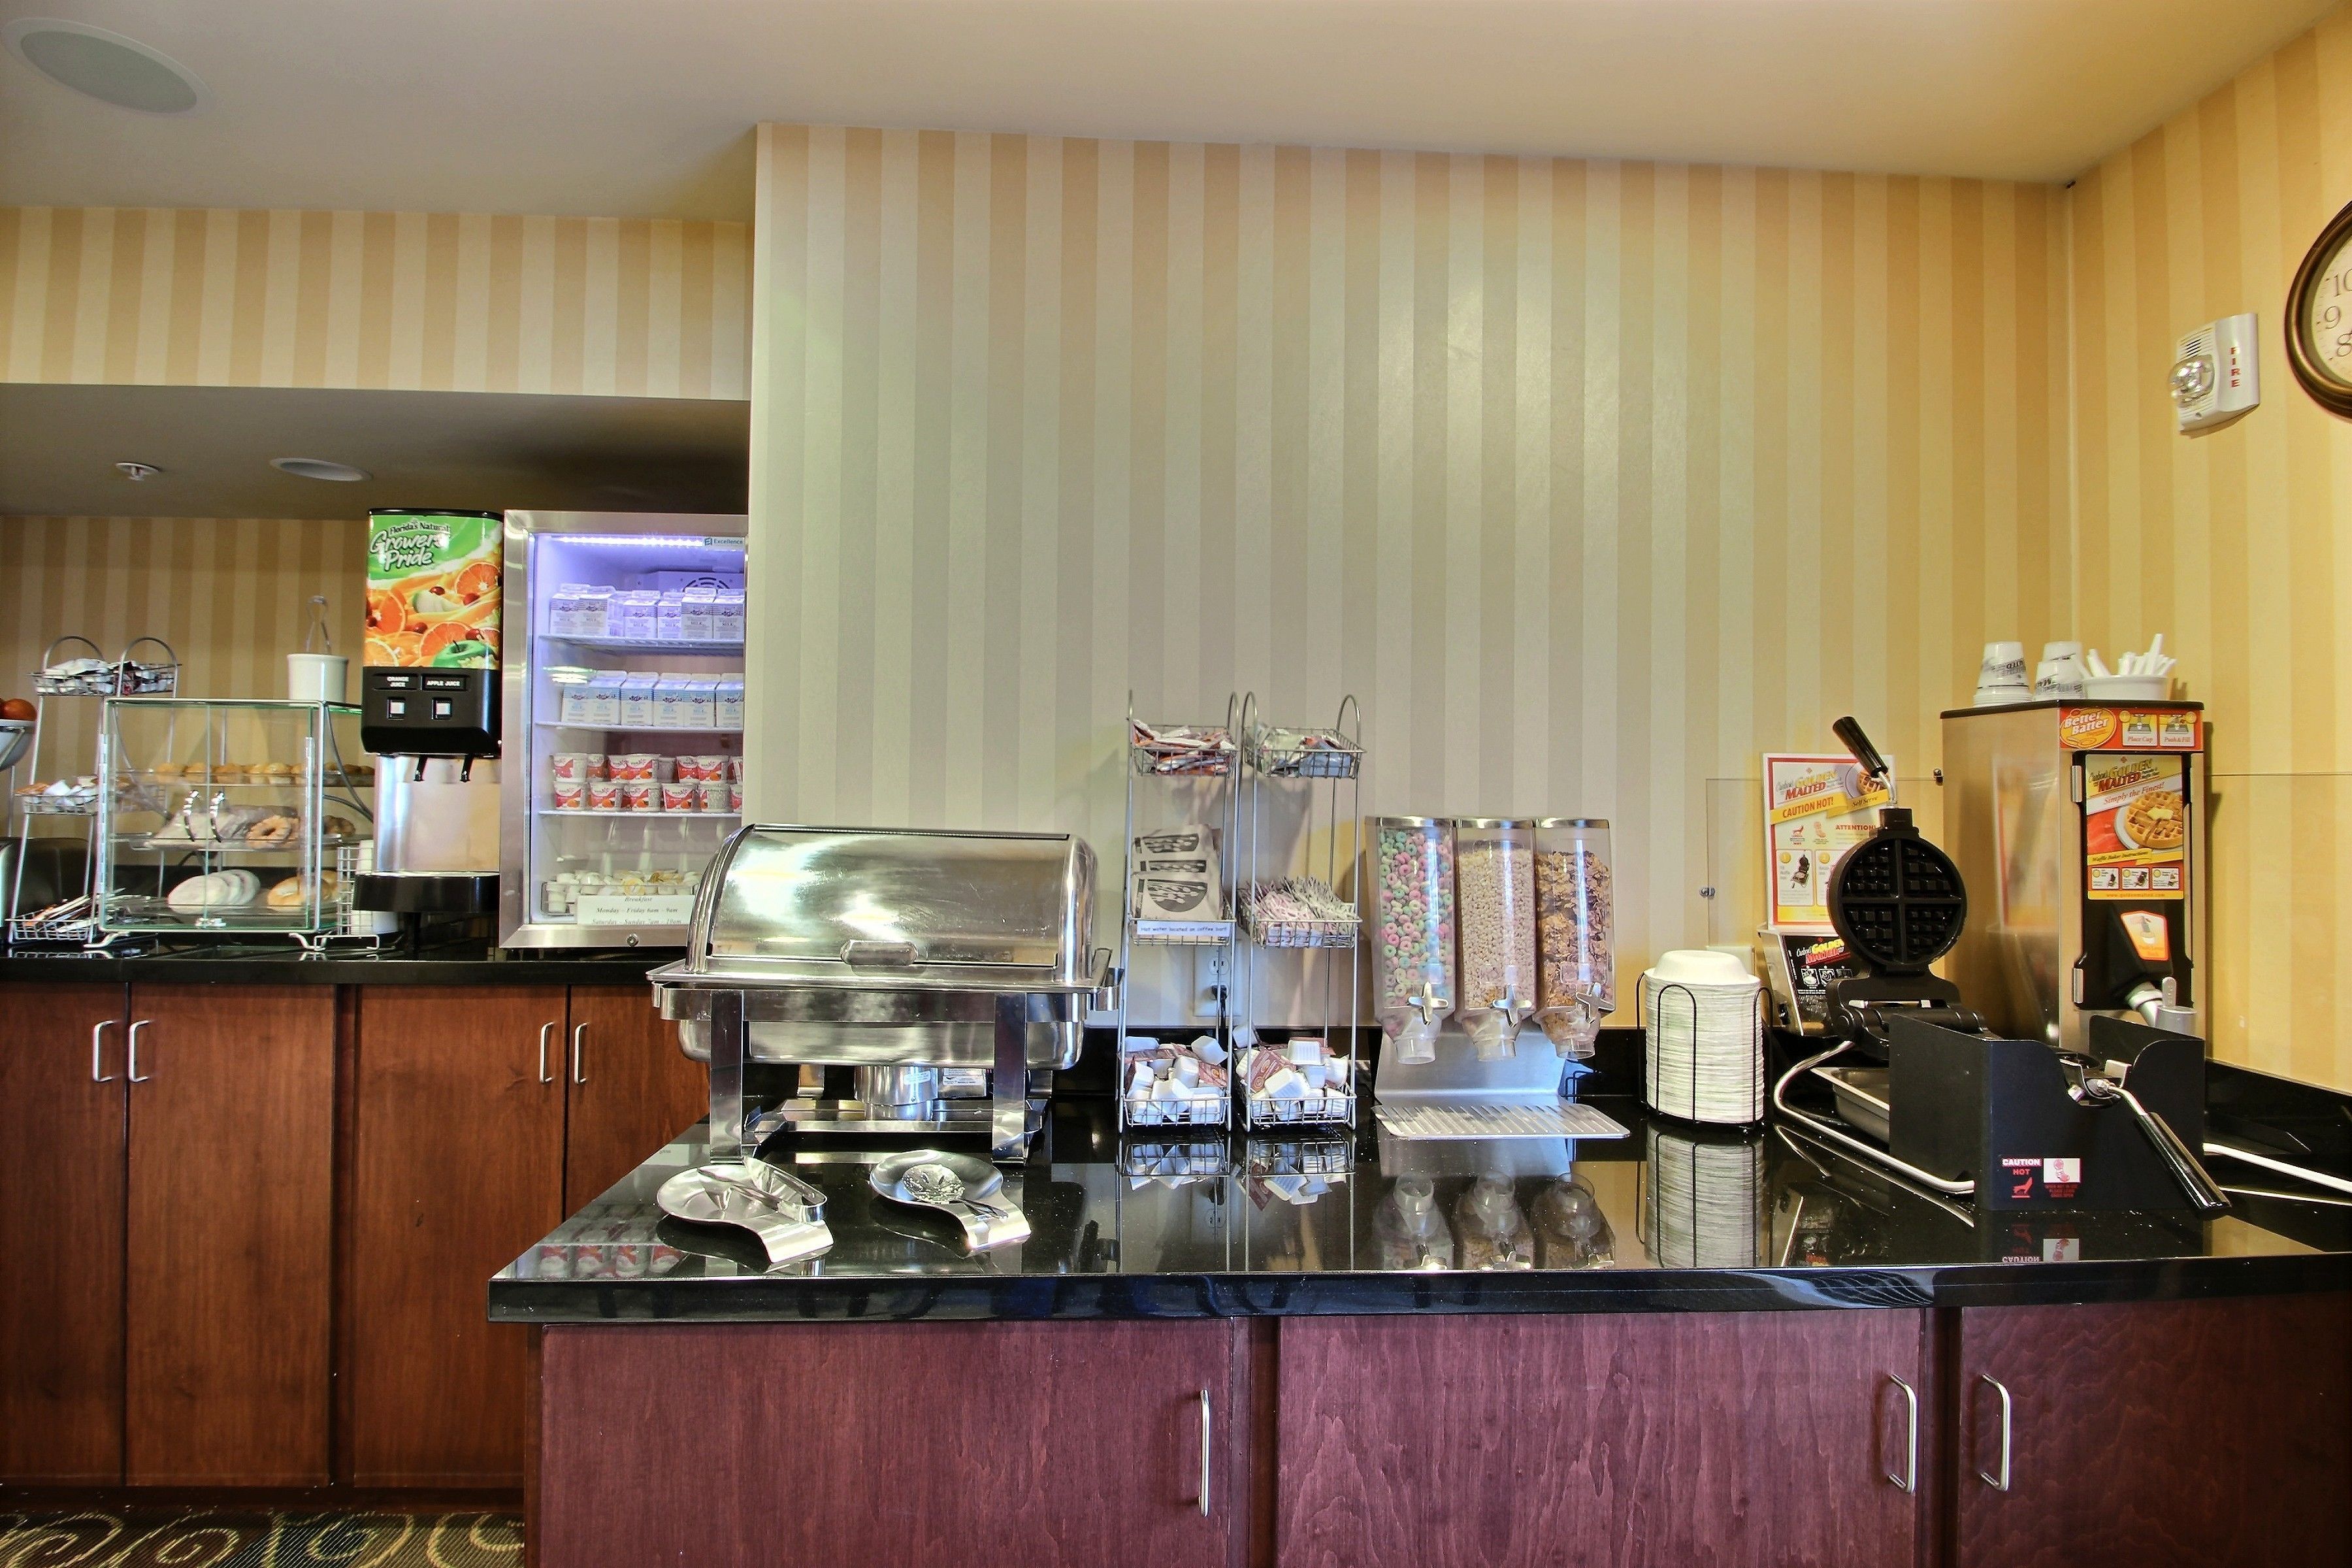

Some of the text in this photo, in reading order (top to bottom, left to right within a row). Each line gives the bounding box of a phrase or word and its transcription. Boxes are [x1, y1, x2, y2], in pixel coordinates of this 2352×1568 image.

[2324, 305, 2342, 329] 9
[2336, 333, 2352, 357] 8
[2230, 347, 2241, 387] FIRE
[384, 547, 433, 572] Pride
[2064, 711, 2103, 728] Better
[2071, 719, 2109, 736] Batter
[1785, 782, 1827, 800] MALTED
[2098, 772, 2142, 792] MALTED
[2104, 792, 2127, 804] Simply
[2129, 789, 2140, 798] the
[1782, 797, 1834, 818] CAUTION HOT!
